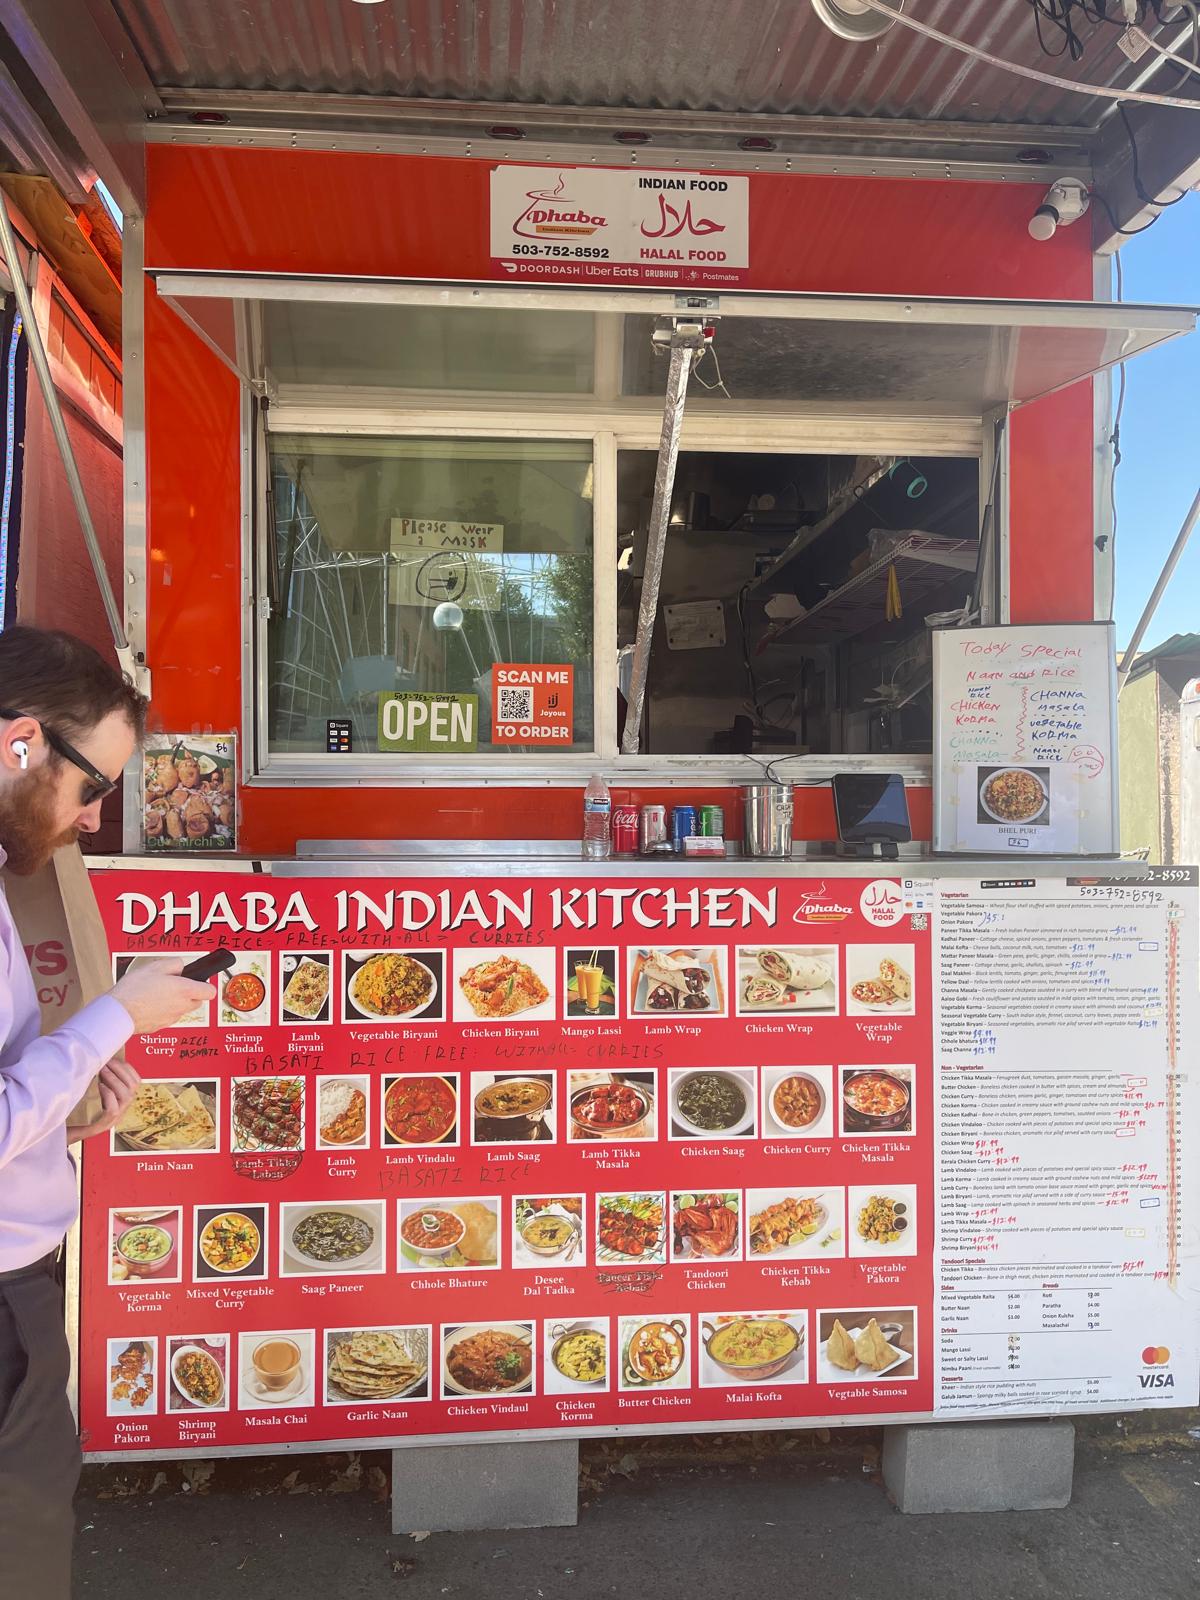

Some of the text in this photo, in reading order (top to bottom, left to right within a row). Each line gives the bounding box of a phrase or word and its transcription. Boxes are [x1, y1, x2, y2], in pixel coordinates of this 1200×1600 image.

[638, 178, 728, 192] INDIAN FOOD
[526, 209, 608, 226] Dhaba
[640, 193, 726, 238] حلال
[512, 244, 609, 258] 503-752-8592
[640, 248, 726, 261] HALAL FOOD
[520, 264, 580, 274] DOORDASH
[586, 266, 610, 276] Uber
[614, 267, 638, 276] Eats
[645, 270, 678, 278] GRUBHUB
[402, 520, 446, 536] Please
[960, 642, 1012, 657] Today
[498, 670, 568, 684] SCAN ME
[540, 710, 566, 718] Joyous
[382, 700, 473, 742] OPEN
[496, 726, 568, 738] TO ORDER
[216, 743, 228, 754] $6
[115, 887, 777, 933] DHABA INDIAN KITCHEN
[801, 904, 855, 914] Dhaba
[462, 1028, 539, 1039] Chicken Biryani
[562, 1026, 621, 1037] Mango Lassi
[645, 1026, 701, 1036] Lamb Wrap
[787, 1024, 812, 1034] Wrap
[856, 1023, 902, 1034] Vegetable
[141, 1035, 177, 1046] Shrimp
[226, 1034, 262, 1044] Shrimp
[292, 1032, 320, 1041] Lamb
[350, 1030, 437, 1042] Vegetable Biryani
[866, 1034, 892, 1044] Wrap
[146, 1046, 175, 1056] Curry
[224, 1044, 264, 1053] Vindalu
[288, 1043, 323, 1054] Biryani
[351, 1046, 406, 1068] RICE
[682, 1147, 744, 1157] Chicken Saag
[764, 1145, 831, 1155] Chicken Curry
[842, 1143, 910, 1152] Chicken Tikka
[488, 1152, 540, 1162] Lamb Saag
[582, 1149, 640, 1158] Lamb Tikka
[328, 1157, 355, 1165] Lamb
[386, 1154, 454, 1164] Lamb Vindalu
[597, 1160, 629, 1168] Masala
[138, 1162, 193, 1171] Plain Naan
[329, 1168, 357, 1178] Curry
[684, 1269, 728, 1278] Tandoori
[762, 1266, 830, 1275] Chicken Tikka
[860, 1264, 906, 1274] Vegetable
[411, 1278, 487, 1289] Chhole Bhature
[535, 1276, 564, 1284] Desee
[782, 1277, 810, 1286] Kebab
[866, 1274, 900, 1284] Pakora
[302, 1284, 363, 1295] Saag Paneer
[687, 1281, 725, 1289] Chicken
[187, 1287, 274, 1299] Mixed Vegetable
[524, 1286, 574, 1295] Dal Tadka
[119, 1291, 172, 1302] Vegetable
[128, 1303, 162, 1312] Korma
[216, 1300, 244, 1310] Curry
[1136, 1374, 1174, 1388] VISA
[727, 1392, 781, 1402] Malai Kofta
[829, 1388, 907, 1400] Vegtable Samosa
[556, 1401, 595, 1410] Chicken
[619, 1396, 690, 1407] Butter Chicken
[448, 1403, 528, 1415] Chicken Vindaul
[347, 1410, 408, 1420] Garlic Naan
[561, 1412, 592, 1420] Korma
[246, 1415, 307, 1426] Masala Chai
[116, 1423, 147, 1431] Onion
[179, 1420, 216, 1432] Shrimp
[115, 1434, 150, 1443] Pakora
[179, 1430, 215, 1442] Biryani
